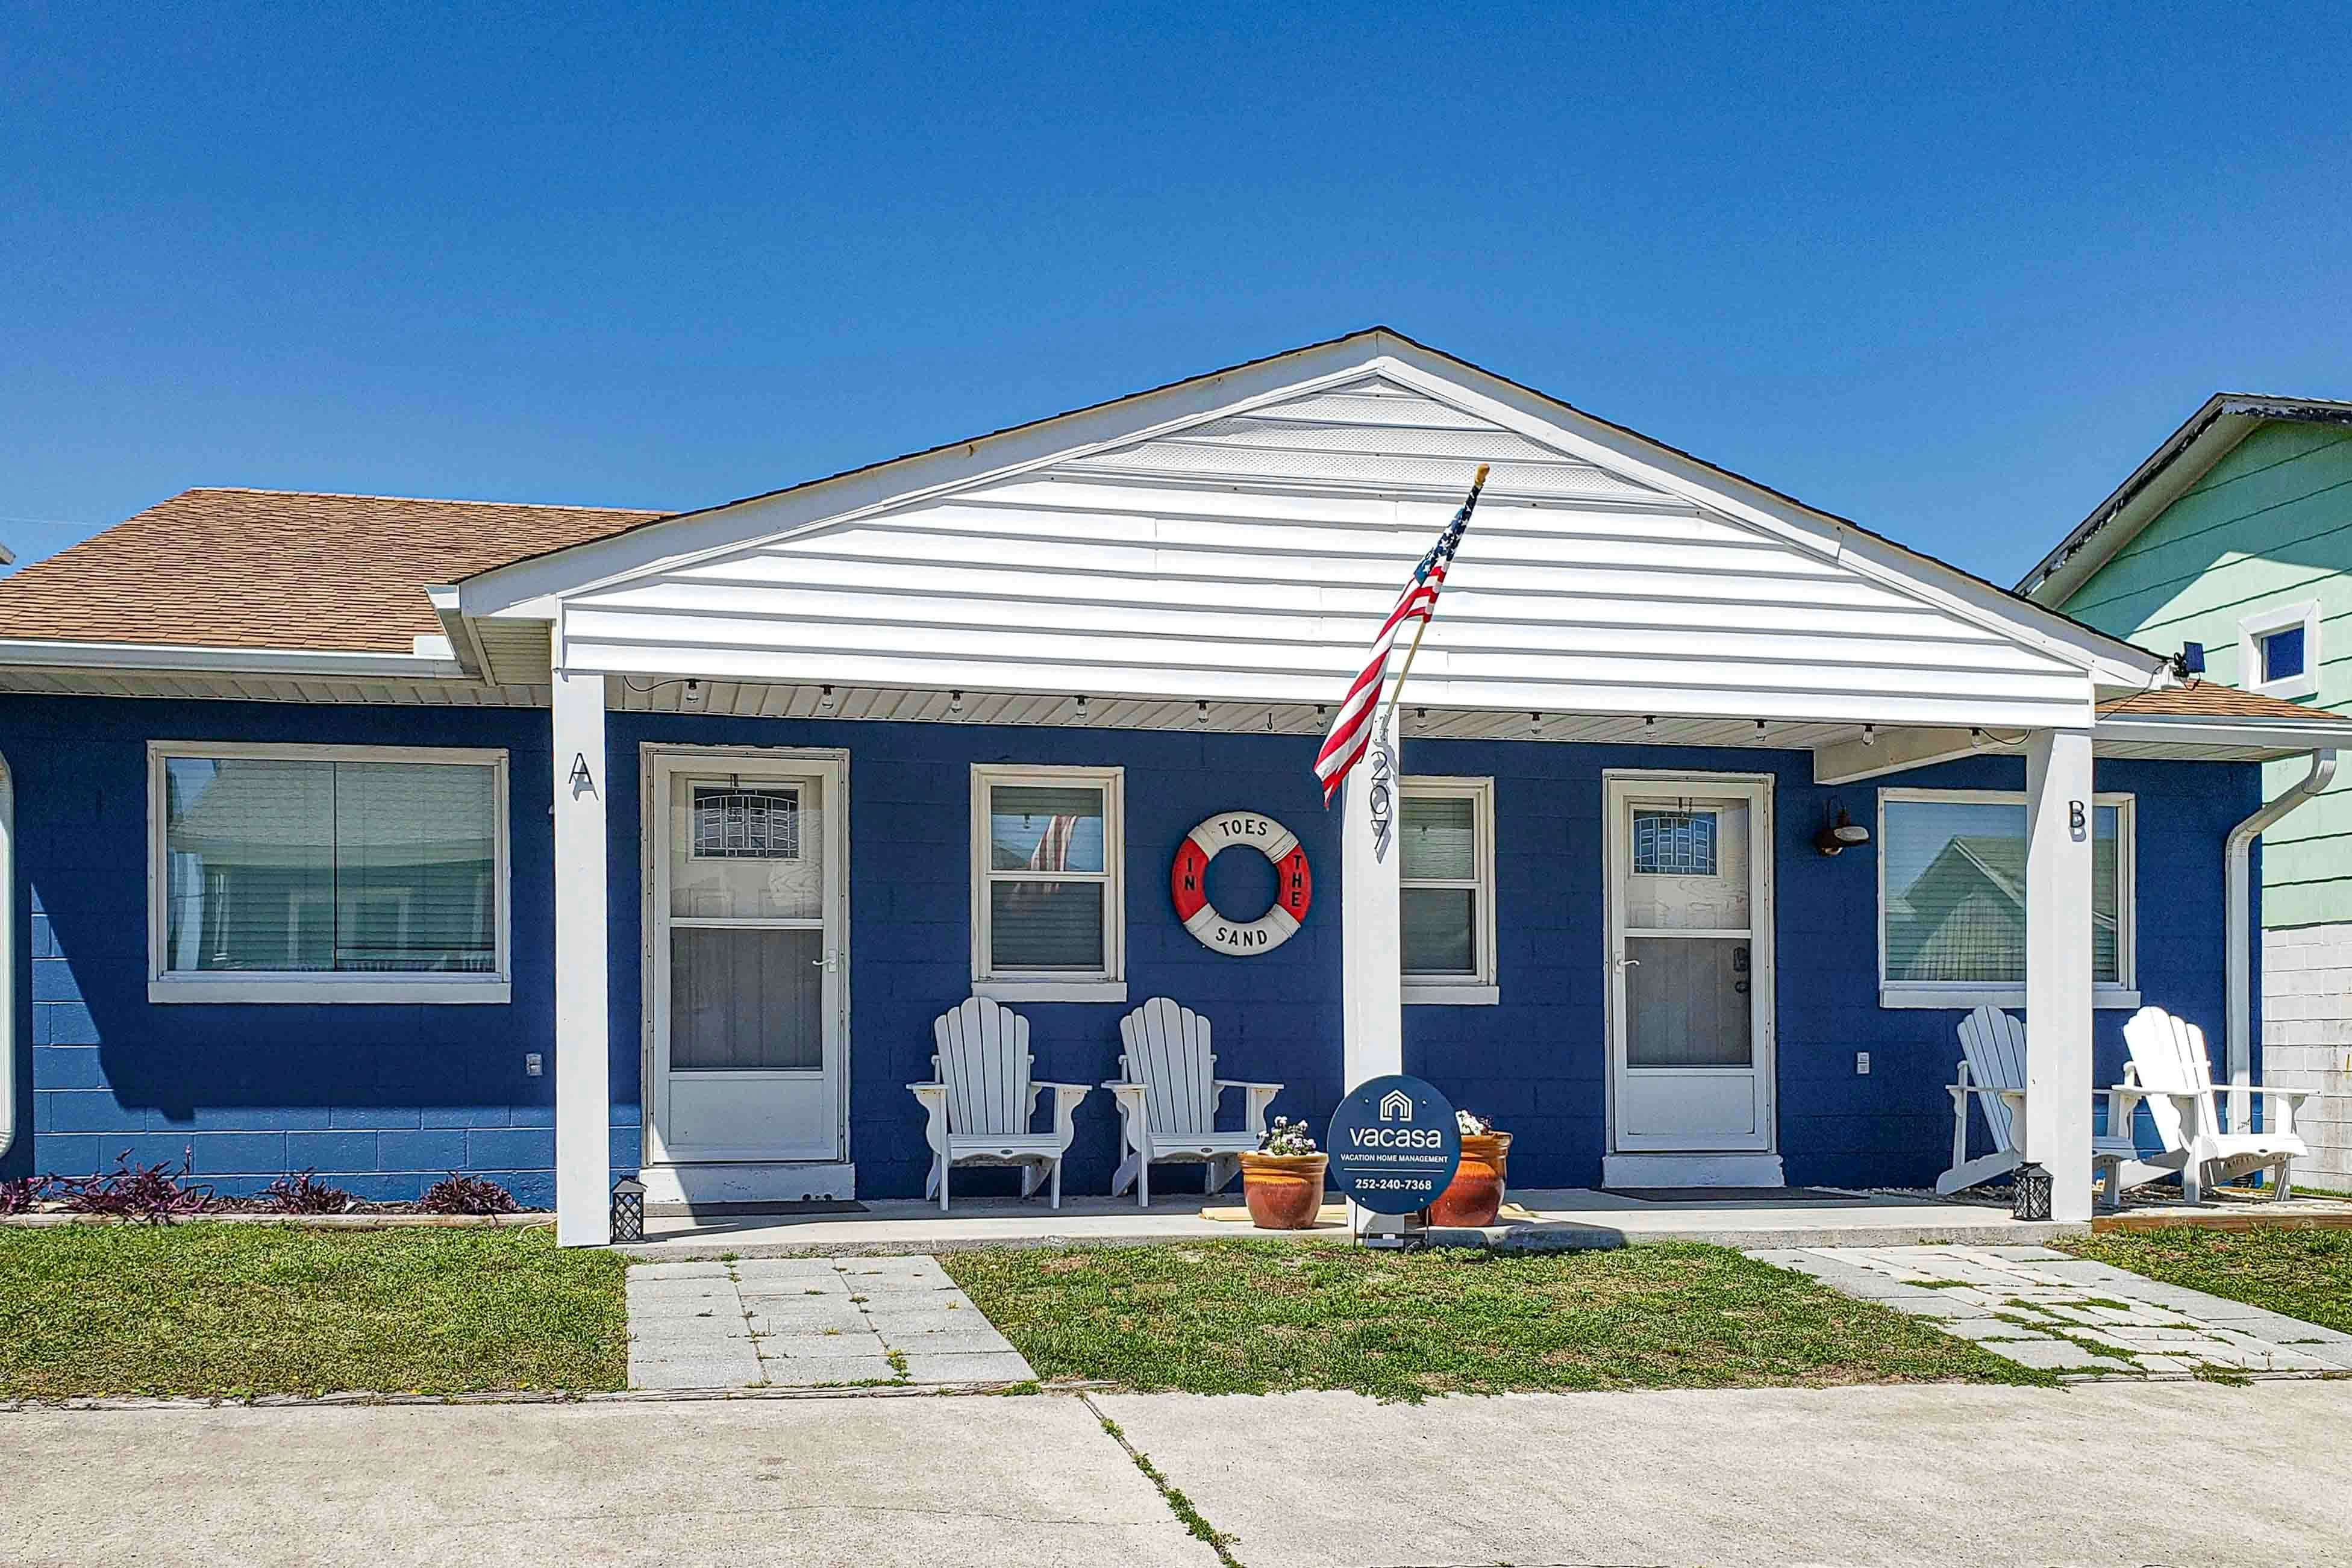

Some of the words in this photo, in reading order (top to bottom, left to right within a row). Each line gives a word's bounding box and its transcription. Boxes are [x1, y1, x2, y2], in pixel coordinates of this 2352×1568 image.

[568, 752, 592, 784] A
[2068, 800, 2086, 828] B
[1219, 819, 1268, 837] TOES
[1184, 857, 1195, 891] IN
[1291, 855, 1303, 907] THE
[1215, 927, 1268, 946] SAND
[1350, 1128, 1442, 1148] vacasa
[1355, 1178, 1432, 1190] 252-240-7368
